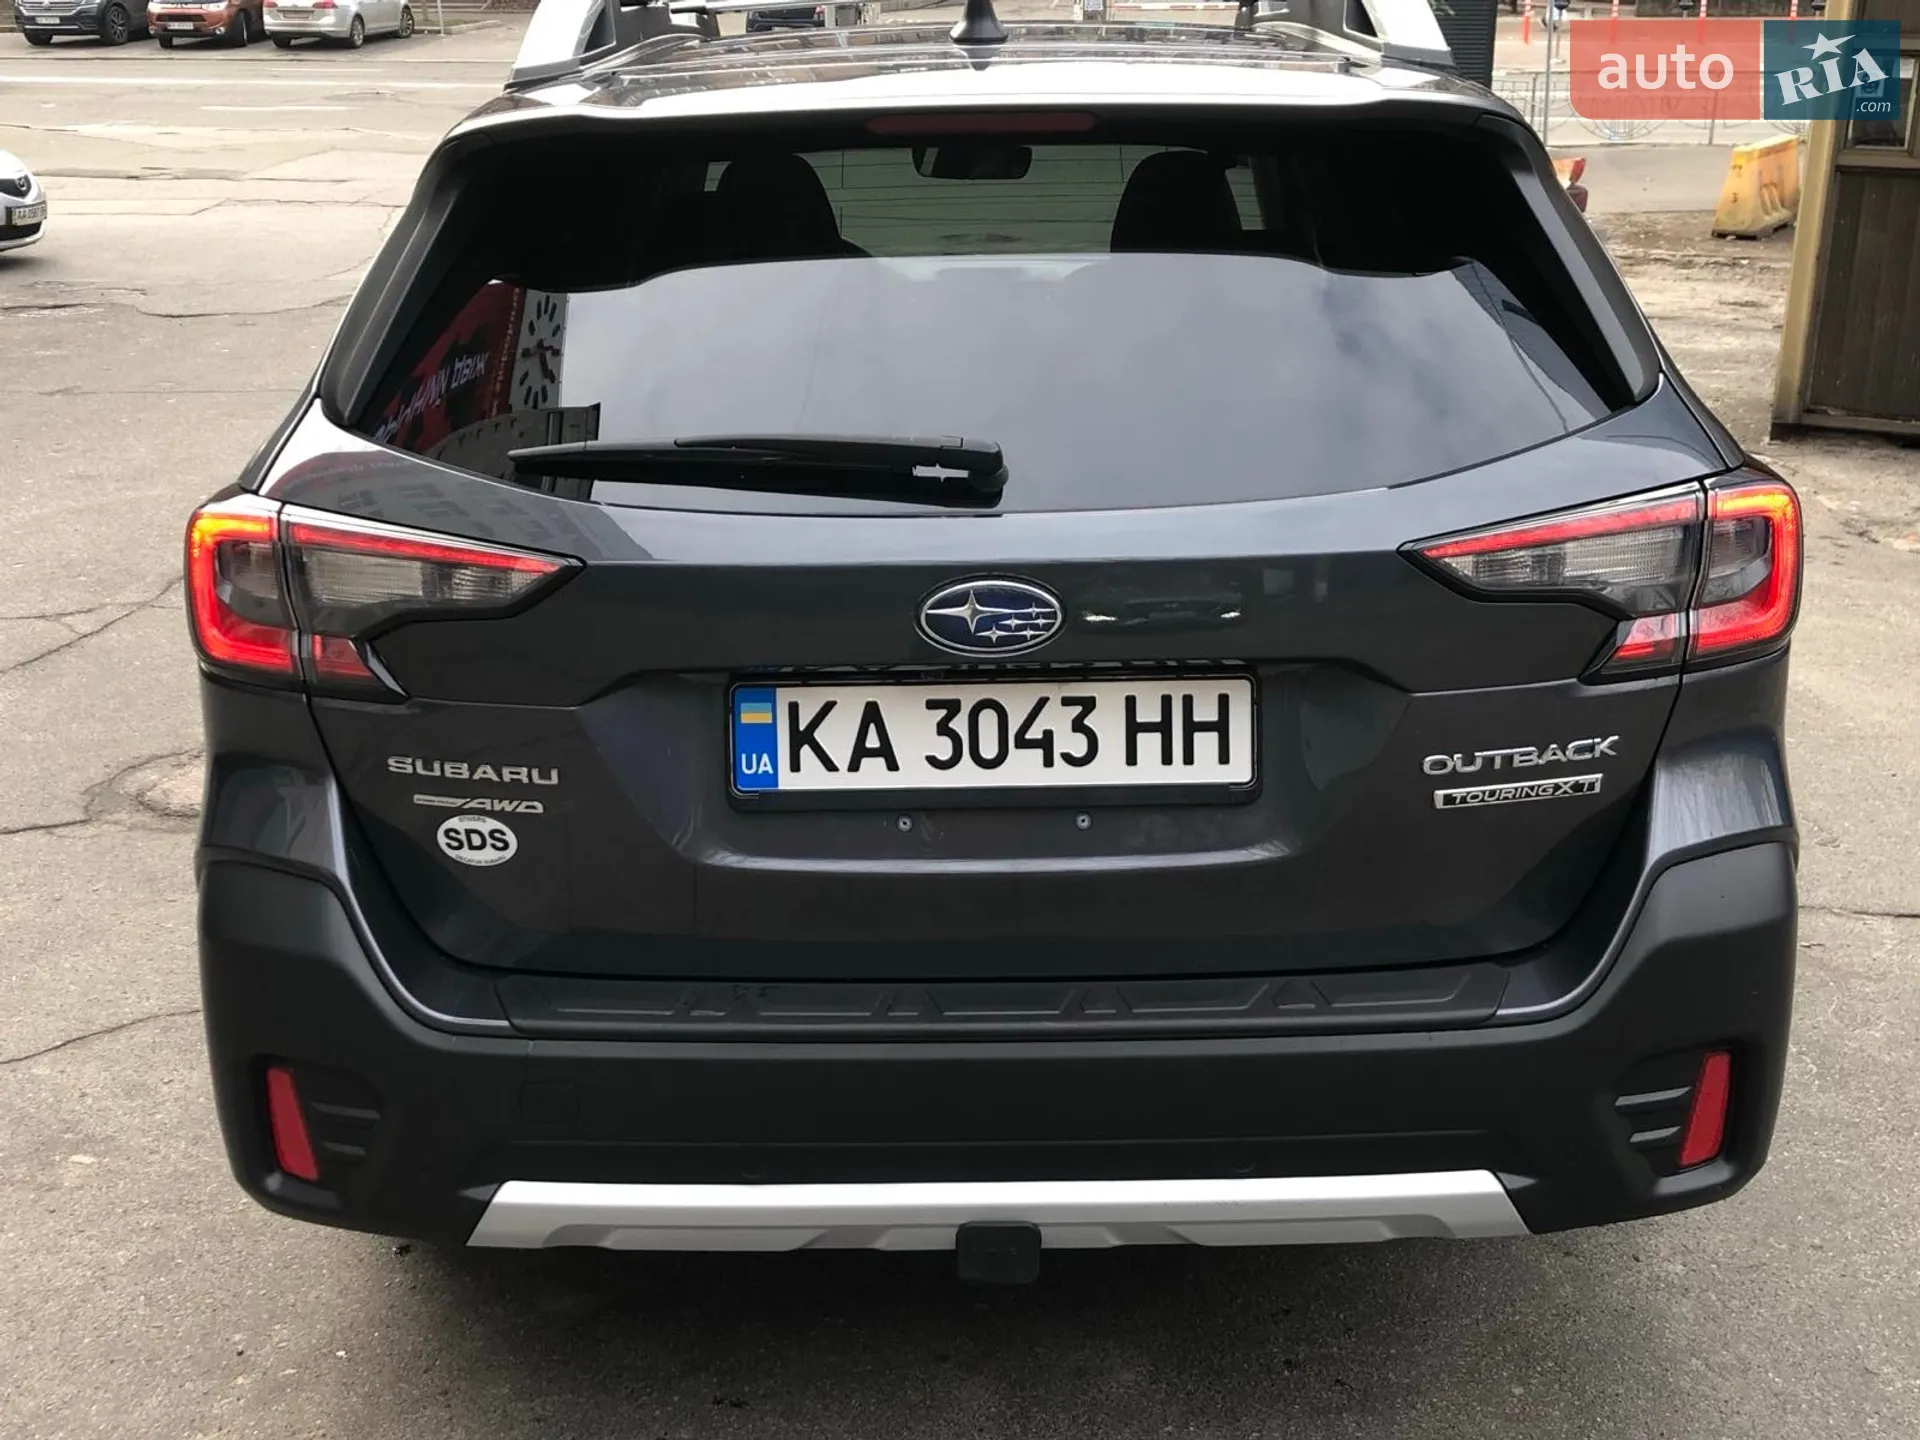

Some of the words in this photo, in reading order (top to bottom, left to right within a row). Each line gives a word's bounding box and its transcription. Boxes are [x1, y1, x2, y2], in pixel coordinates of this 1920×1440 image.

[788, 701, 899, 772] KA
[925, 696, 1098, 770] 3043
[1125, 693, 1229, 766] HH
[742, 753, 773, 775] UA
[1423, 735, 1620, 776] OUTBACK
[387, 756, 559, 785] SUBARU
[461, 798, 544, 813] AWD
[444, 827, 510, 851] SDS
